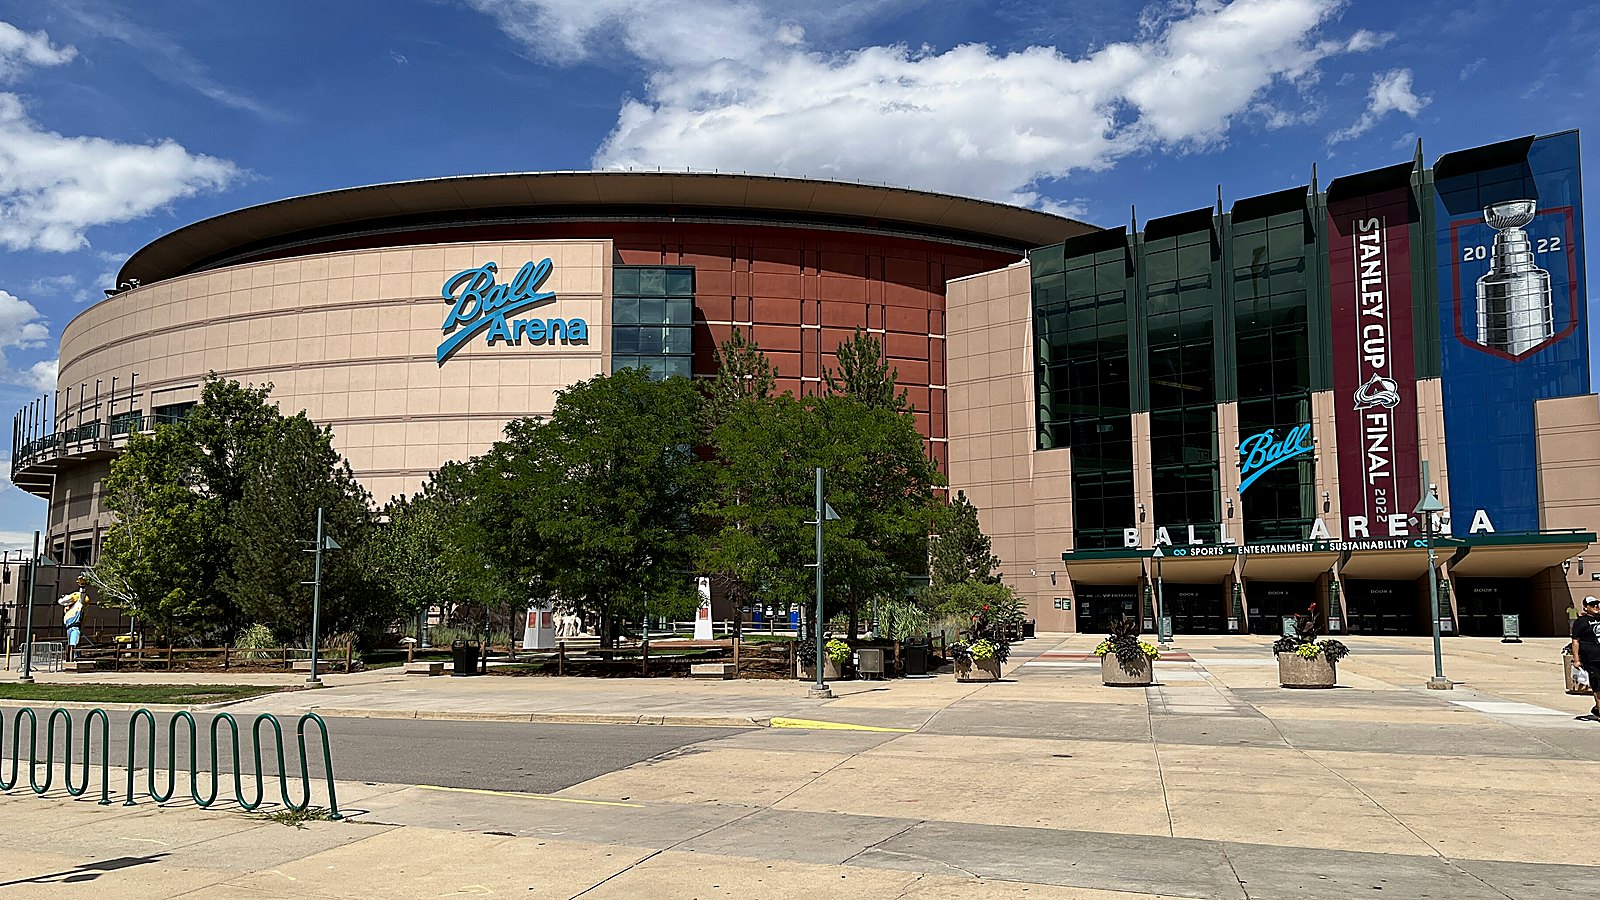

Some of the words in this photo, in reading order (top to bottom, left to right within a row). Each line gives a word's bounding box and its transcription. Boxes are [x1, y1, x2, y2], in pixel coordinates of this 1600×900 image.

[1463, 245, 1487, 262] 20
[1537, 237, 1561, 253] 22
[1358, 217, 1384, 319] STANLEY
[437, 257, 556, 356] Ball
[485, 313, 588, 344] Arena
[1363, 324, 1385, 369] CUP
[1239, 423, 1314, 489] Ball
[1366, 413, 1390, 485] FINAL
[1374, 488, 1388, 523] 2022
[1123, 523, 1236, 548] BALL
[1309, 509, 1495, 540] ARENA
[1190, 547, 1223, 556] SPORTS
[1238, 543, 1314, 555] ENTERTAINMENT
[1329, 539, 1408, 551] SUSTAINABILITY
